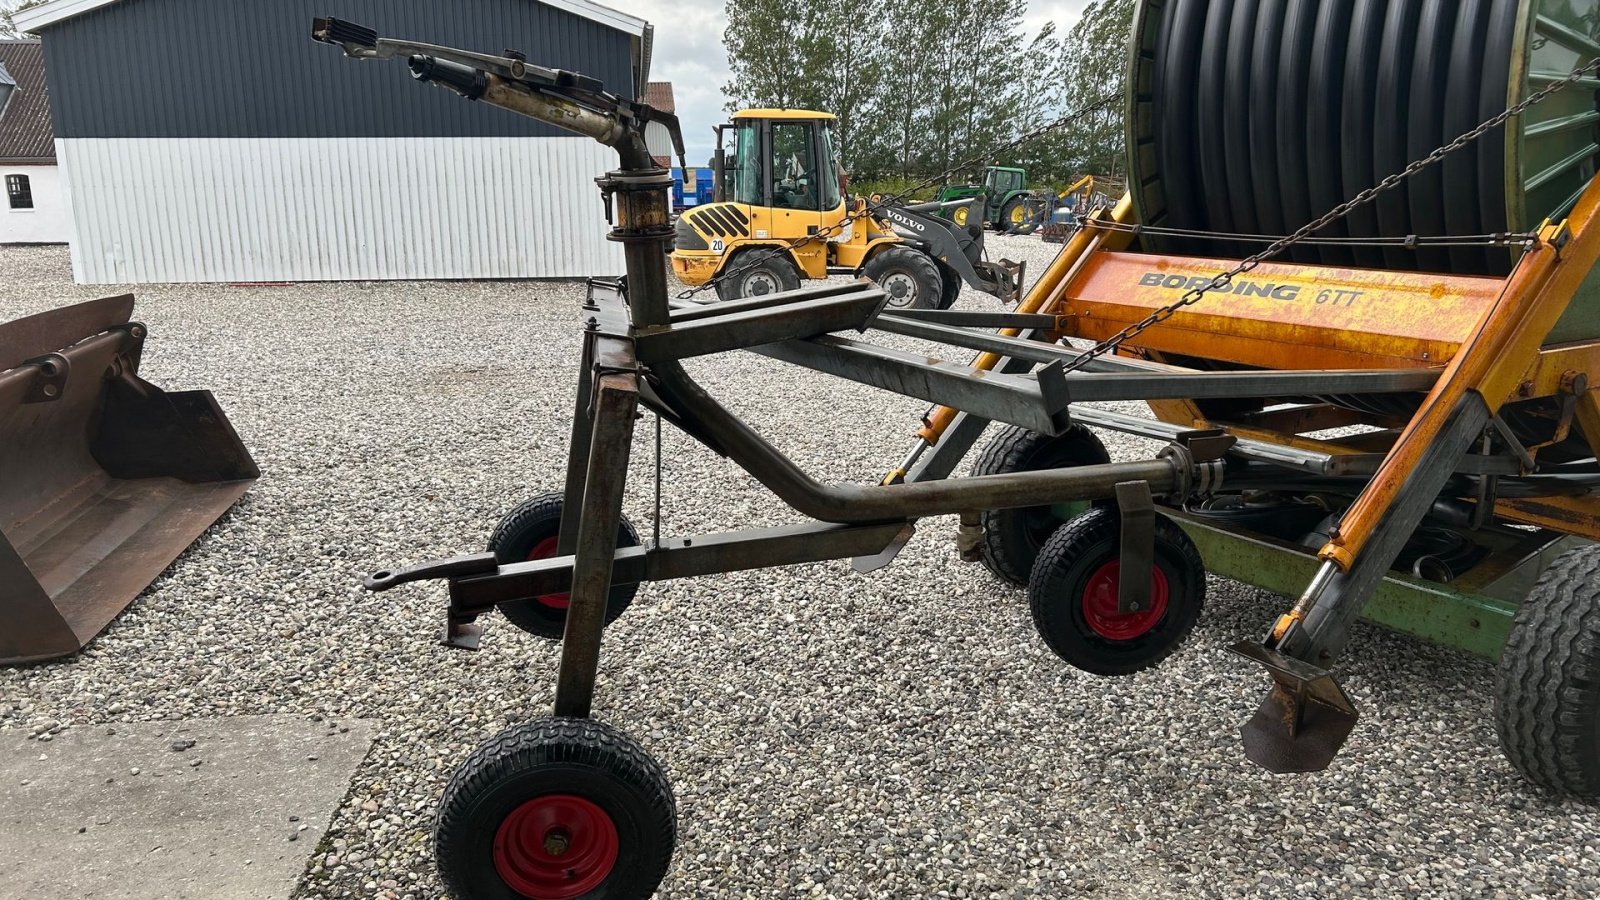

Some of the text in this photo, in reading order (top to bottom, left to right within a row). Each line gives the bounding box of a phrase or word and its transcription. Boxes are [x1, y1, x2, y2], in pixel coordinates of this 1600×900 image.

[886, 209, 925, 231] VOLVO
[712, 240, 723, 251] 20
[1315, 288, 1364, 307] 6TT
